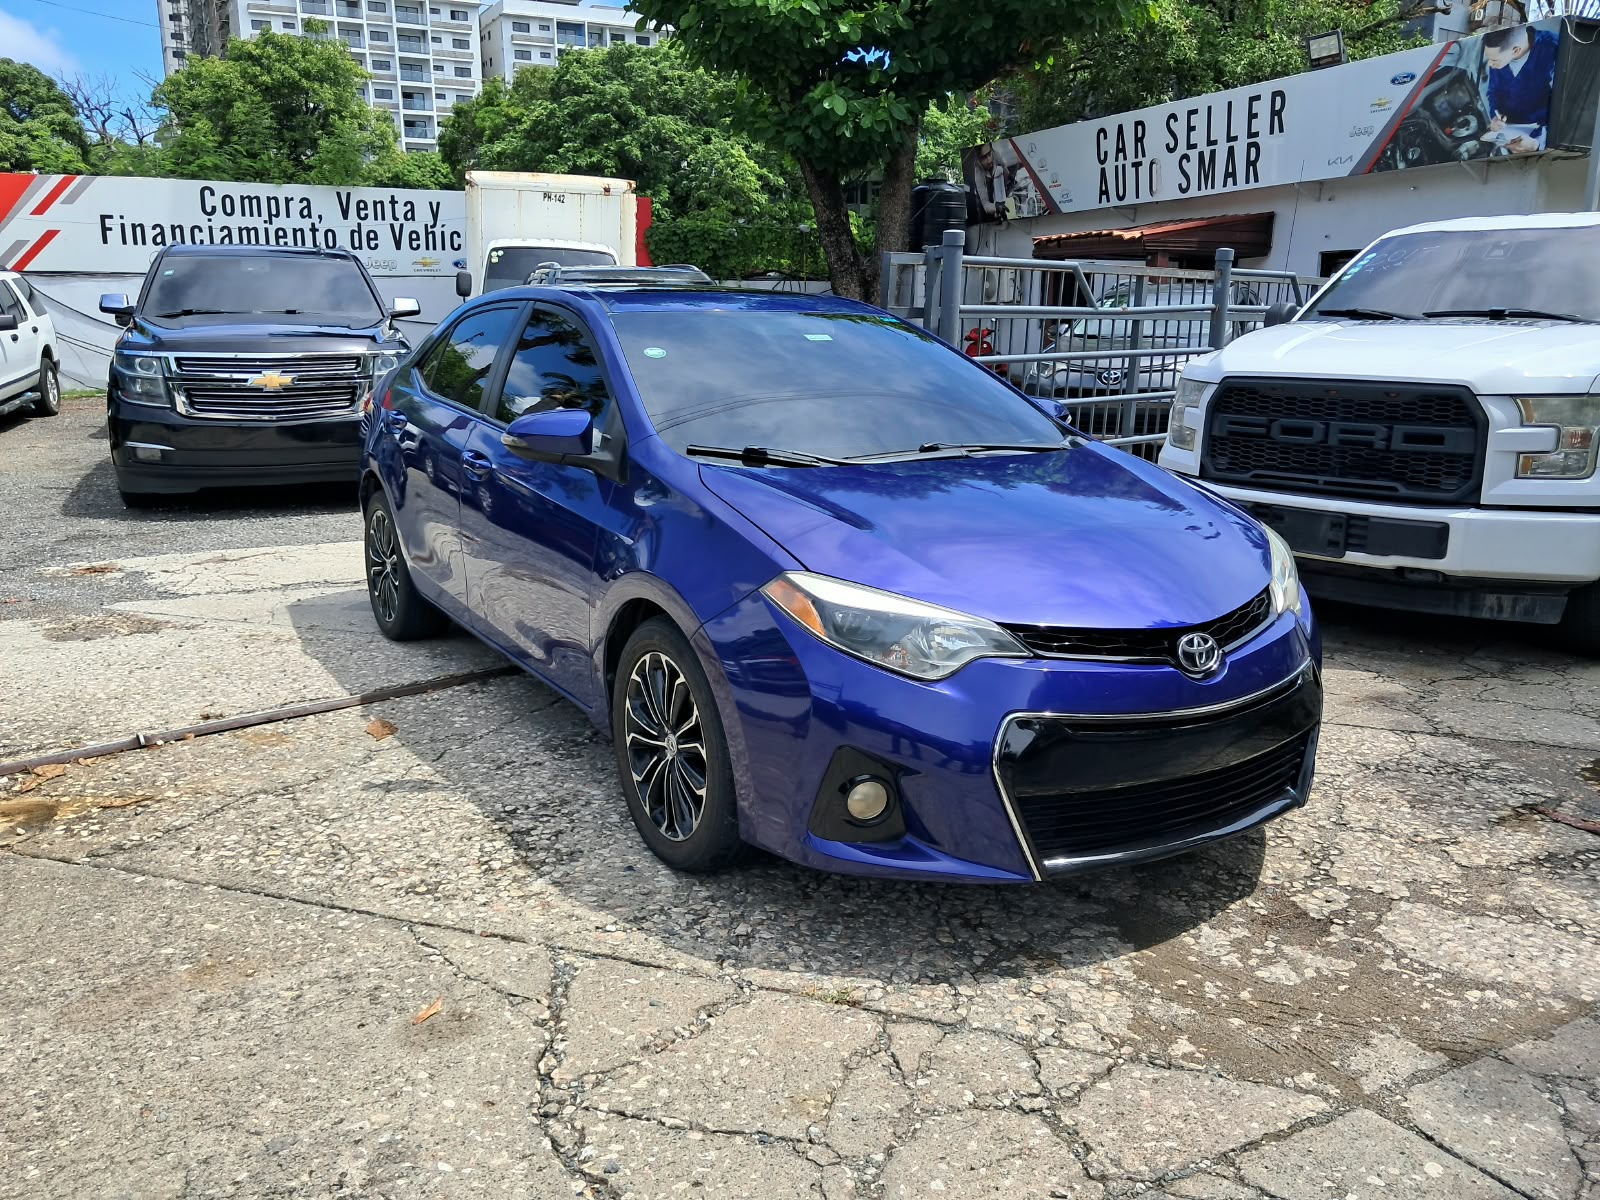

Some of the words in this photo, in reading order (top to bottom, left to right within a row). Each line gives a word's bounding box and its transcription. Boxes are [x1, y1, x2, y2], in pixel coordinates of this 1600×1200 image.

[1096, 120, 1147, 166] CAR
[1165, 90, 1287, 154] SELLER
[1349, 126, 1375, 138] Jeep
[1098, 158, 1162, 205] AUTO
[1178, 141, 1261, 194] SMAR
[199, 186, 323, 225] Compra,
[336, 191, 416, 223] Venta
[428, 201, 441, 229] y
[100, 214, 337, 249] Financiamiento
[350, 222, 379, 251] de
[389, 223, 466, 251] Vehíc
[365, 257, 397, 271] Jeep
[1211, 414, 1458, 453] FORD
